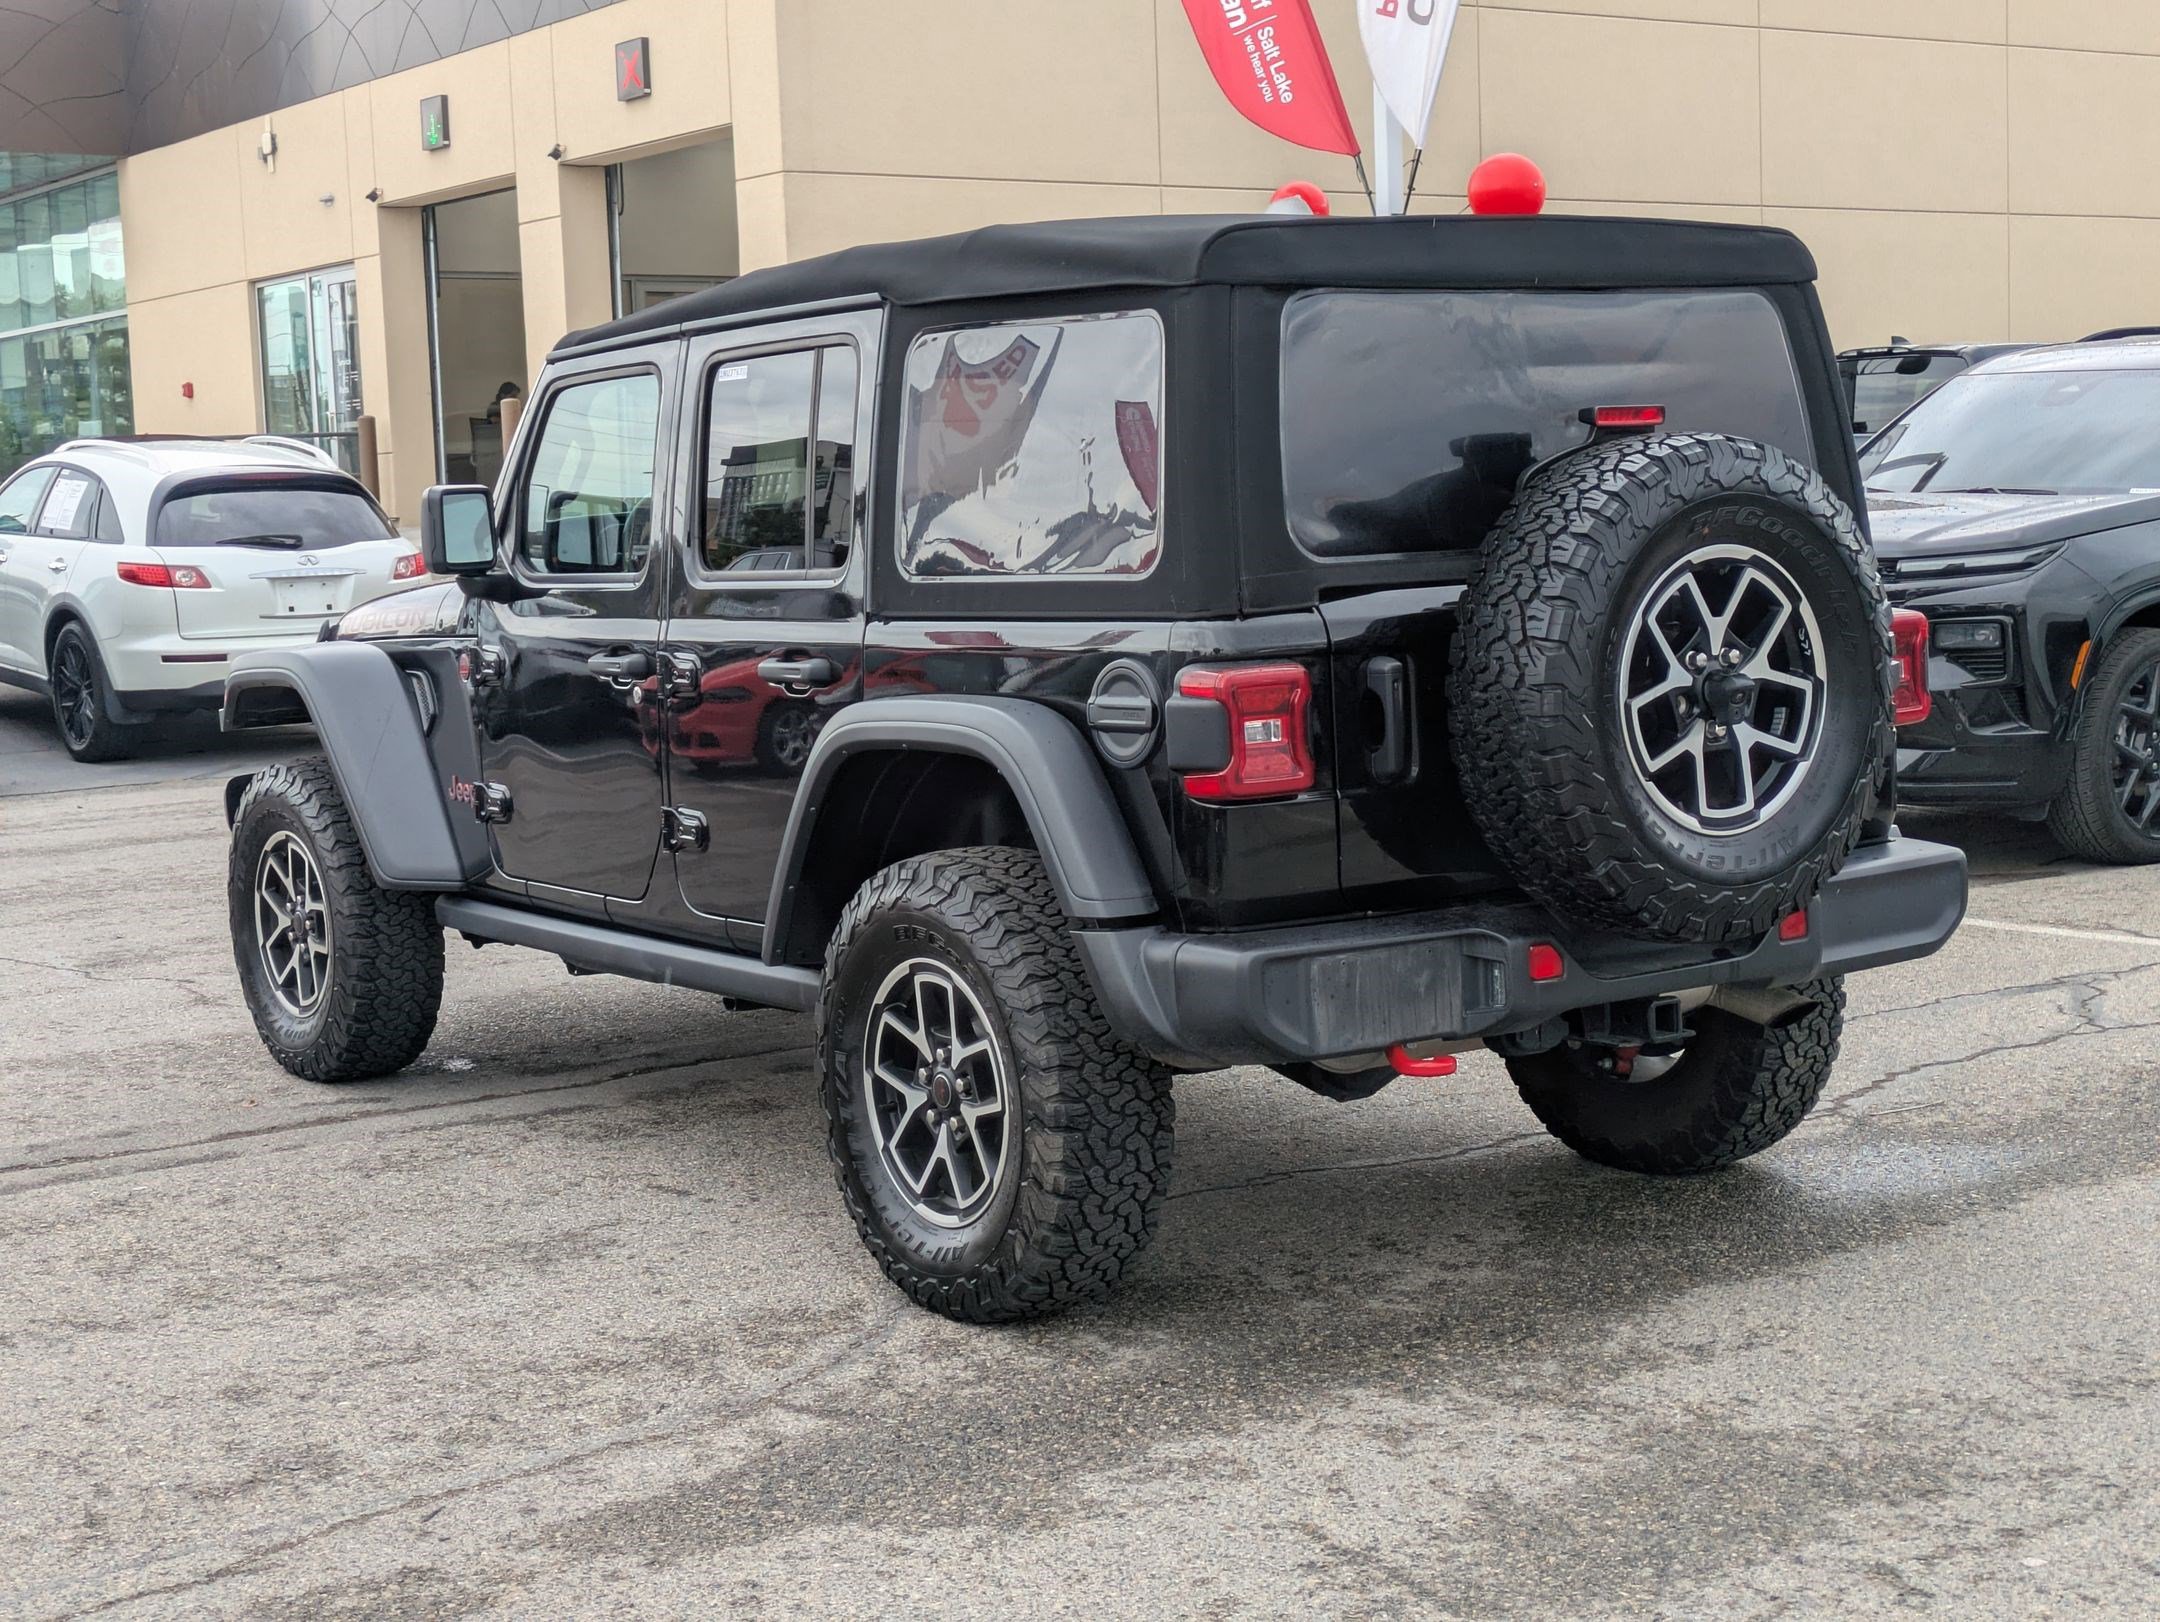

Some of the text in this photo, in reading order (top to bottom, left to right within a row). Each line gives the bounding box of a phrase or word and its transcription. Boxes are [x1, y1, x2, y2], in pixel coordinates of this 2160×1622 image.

[1243, 34, 1274, 103] we hear you
[1257, 26, 1281, 61] Salt
[1269, 60, 1293, 104] Lake
